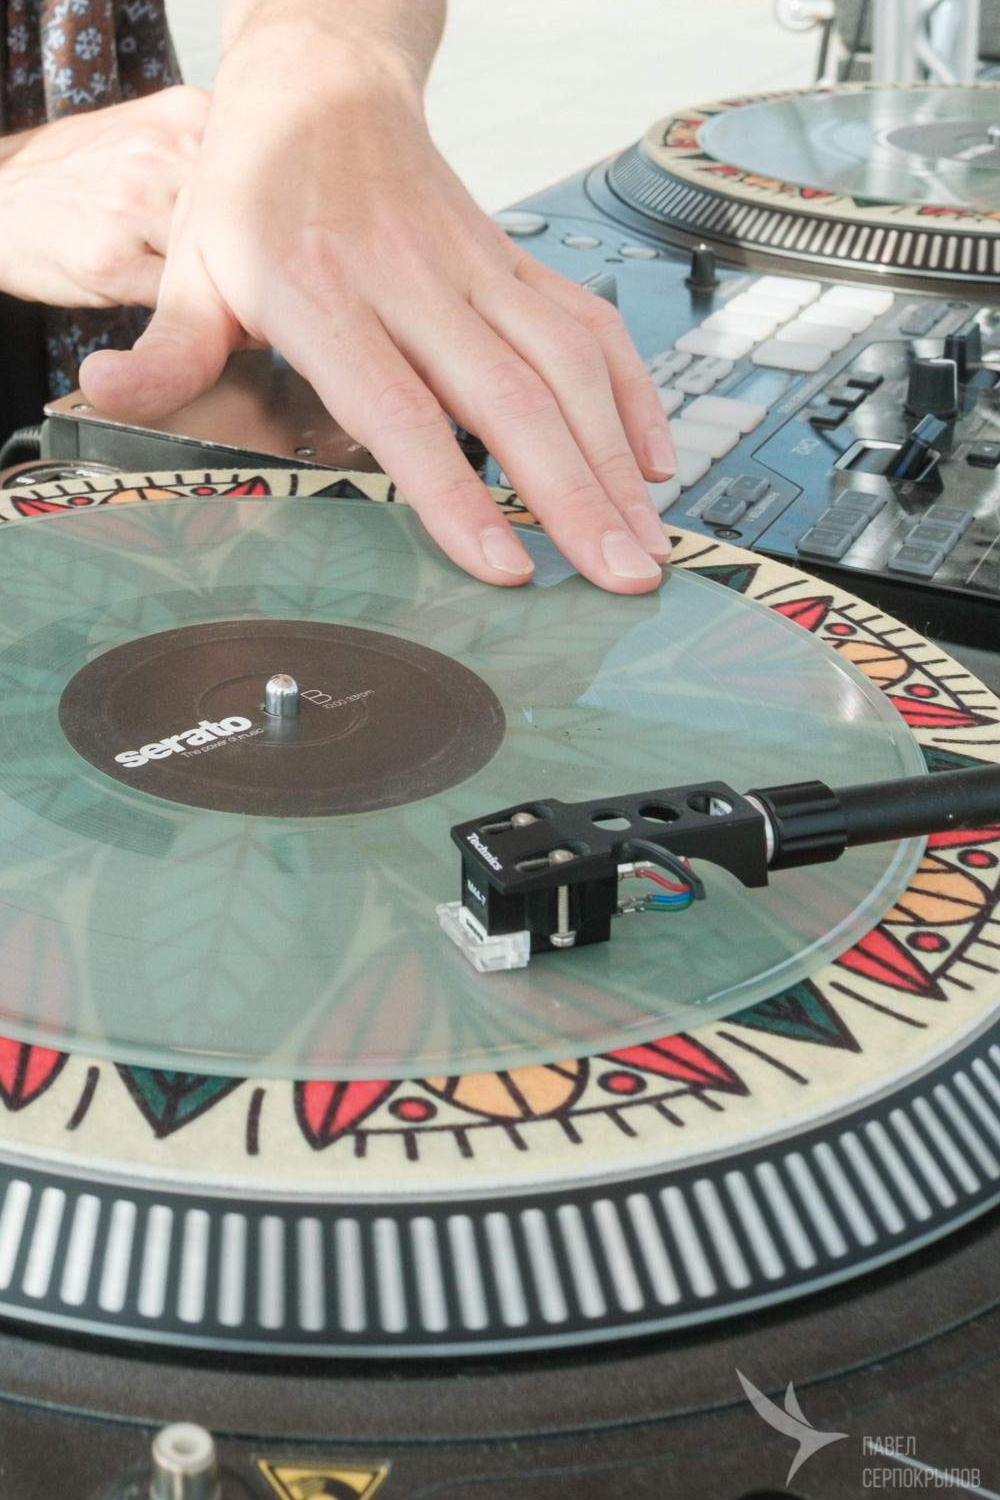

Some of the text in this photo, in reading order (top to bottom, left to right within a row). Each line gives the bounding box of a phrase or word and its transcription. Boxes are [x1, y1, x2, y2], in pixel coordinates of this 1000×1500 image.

[300, 689, 332, 705] B
[114, 716, 252, 768] serato
[466, 832, 503, 871] Technics
